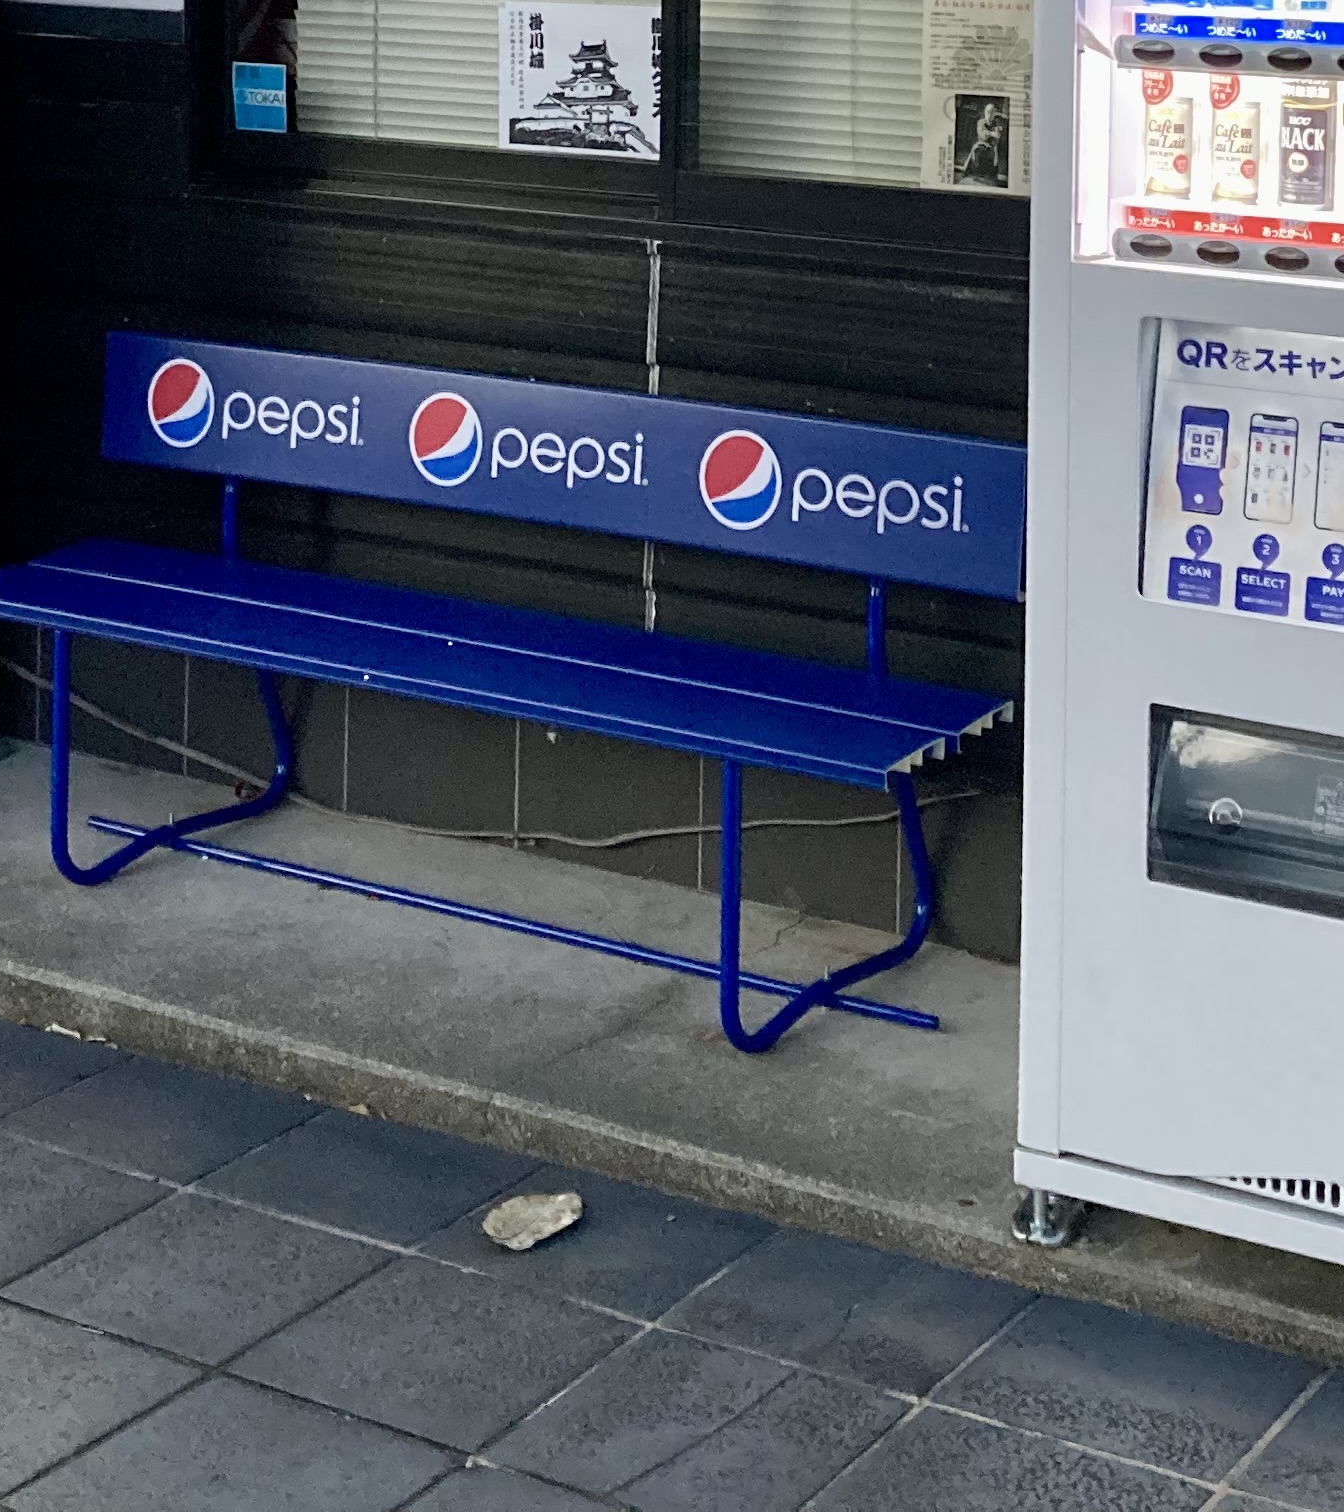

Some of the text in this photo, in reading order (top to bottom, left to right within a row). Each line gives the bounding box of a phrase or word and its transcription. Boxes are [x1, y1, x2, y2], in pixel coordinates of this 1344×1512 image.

[247, 91, 284, 105] TOKAI
[1148, 118, 1173, 138] Café
[1215, 123, 1240, 142] Café
[1162, 134, 1186, 149] Lait
[1229, 140, 1253, 154] Lait
[1281, 125, 1326, 152] BLACK
[222, 388, 361, 450] pepsi
[491, 425, 646, 489] pepsi
[791, 467, 970, 535] pepsi
[1195, 533, 1203, 546] 1
[1261, 543, 1271, 556] 2
[1331, 552, 1340, 565] 3
[1179, 564, 1212, 580] SCAN
[1241, 573, 1287, 591] SELECT
